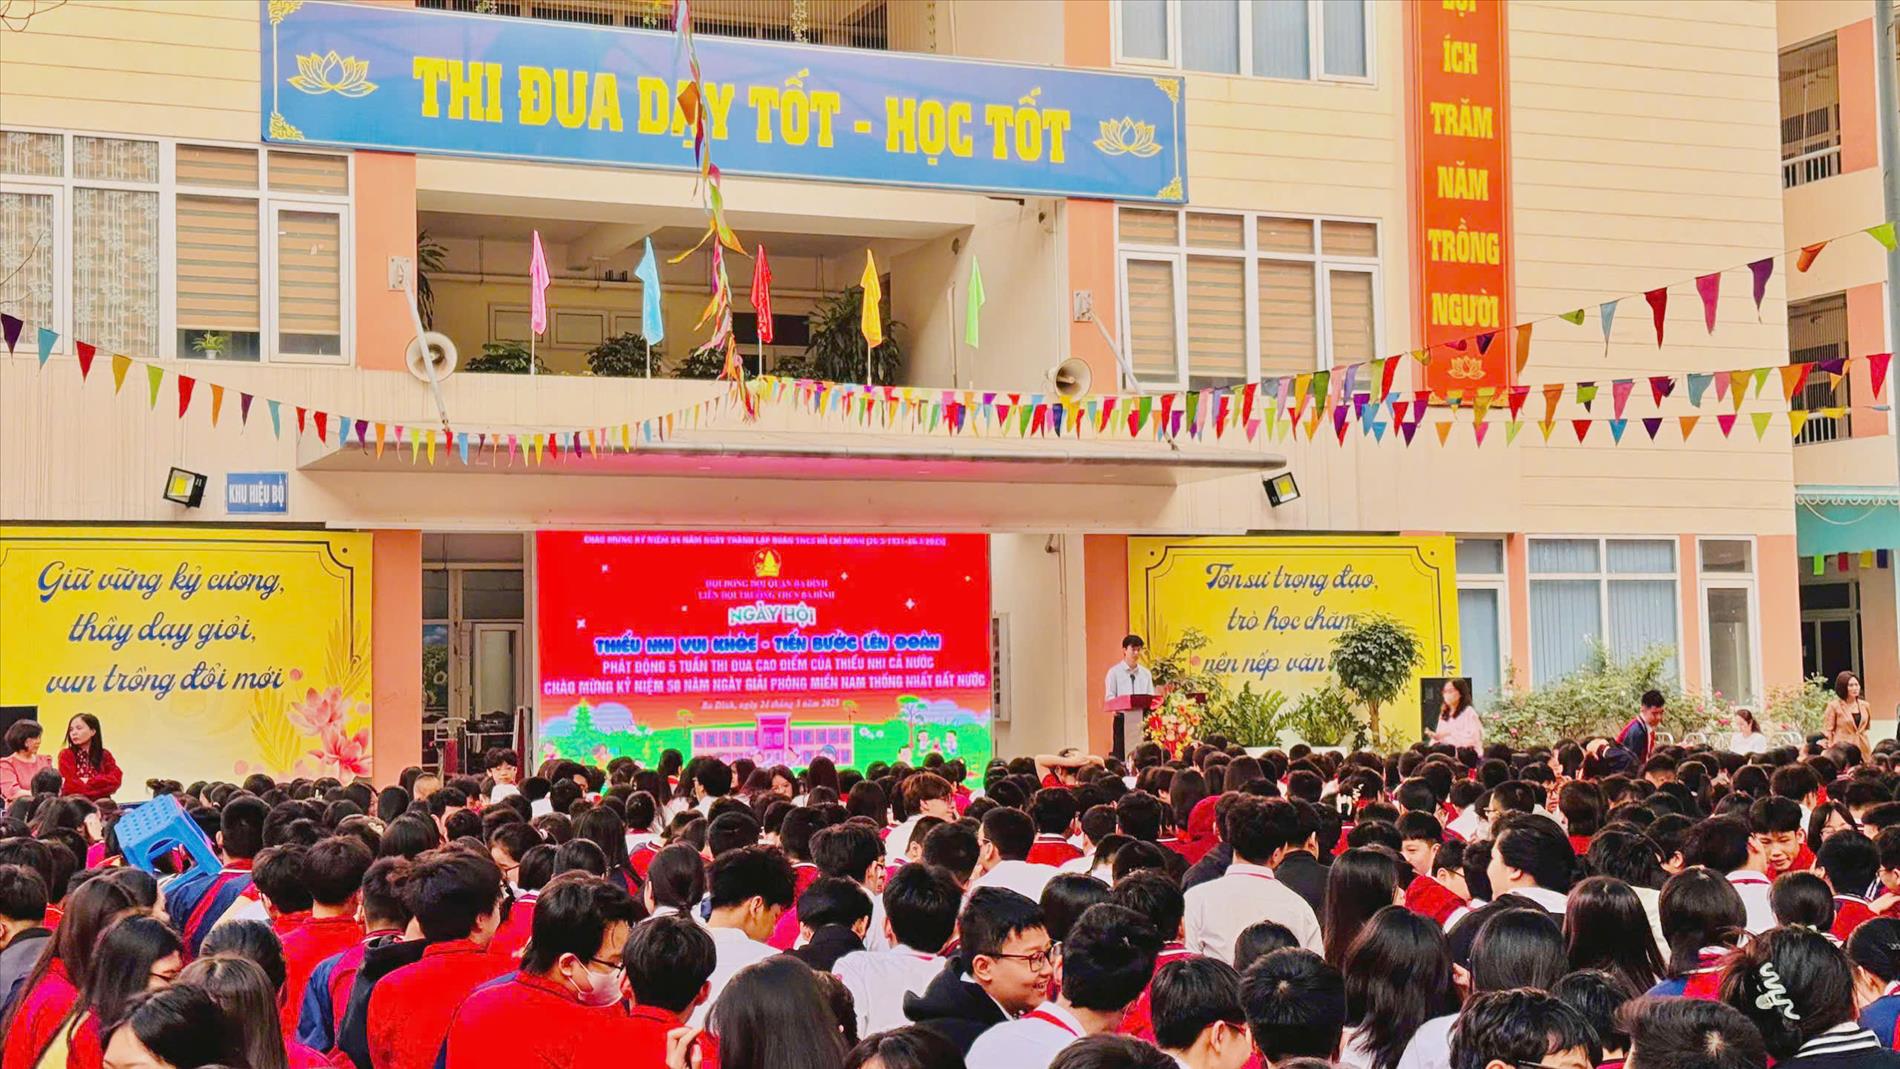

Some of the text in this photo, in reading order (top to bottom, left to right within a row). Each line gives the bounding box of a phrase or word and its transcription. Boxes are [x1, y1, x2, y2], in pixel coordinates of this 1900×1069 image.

[1443, 34, 1478, 75] ÍCH
[413, 56, 503, 123] THI
[518, 65, 623, 132] ĐUA
[748, 68, 840, 148] TỐT
[854, 120, 871, 133] -
[885, 96, 973, 165] HỌC
[985, 87, 1071, 163] TỐT
[1430, 97, 1493, 139] TRĂM
[1437, 160, 1488, 201] NĂM
[1428, 217, 1499, 265] TRỒNG
[1432, 288, 1499, 328] NGƯỜI
[228, 475, 285, 507] KHU HIỆU BỘ
[38, 561, 94, 602] Giữ
[98, 567, 163, 600] vững
[207, 570, 284, 600] cương,
[1206, 563, 1378, 597] Tôn sư trọng đạo,
[69, 612, 256, 650] thầy dạy giỏi,
[728, 600, 816, 627] NGÀY HỘI
[1227, 607, 1259, 631] trò
[1263, 606, 1300, 635] học
[595, 630, 641, 655] THIẾU
[645, 636, 676, 654] NHI
[679, 636, 708, 654] VUI
[774, 628, 807, 652] TIẾN
[812, 629, 858, 652] BƯỚC
[862, 630, 889, 651] LÊN
[894, 629, 941, 650] ĐOÀN
[46, 661, 284, 700] vun trồng đổi mới
[1203, 651, 1238, 673] nền
[1242, 650, 1279, 680] nếp
[1286, 652, 1326, 672] văn
